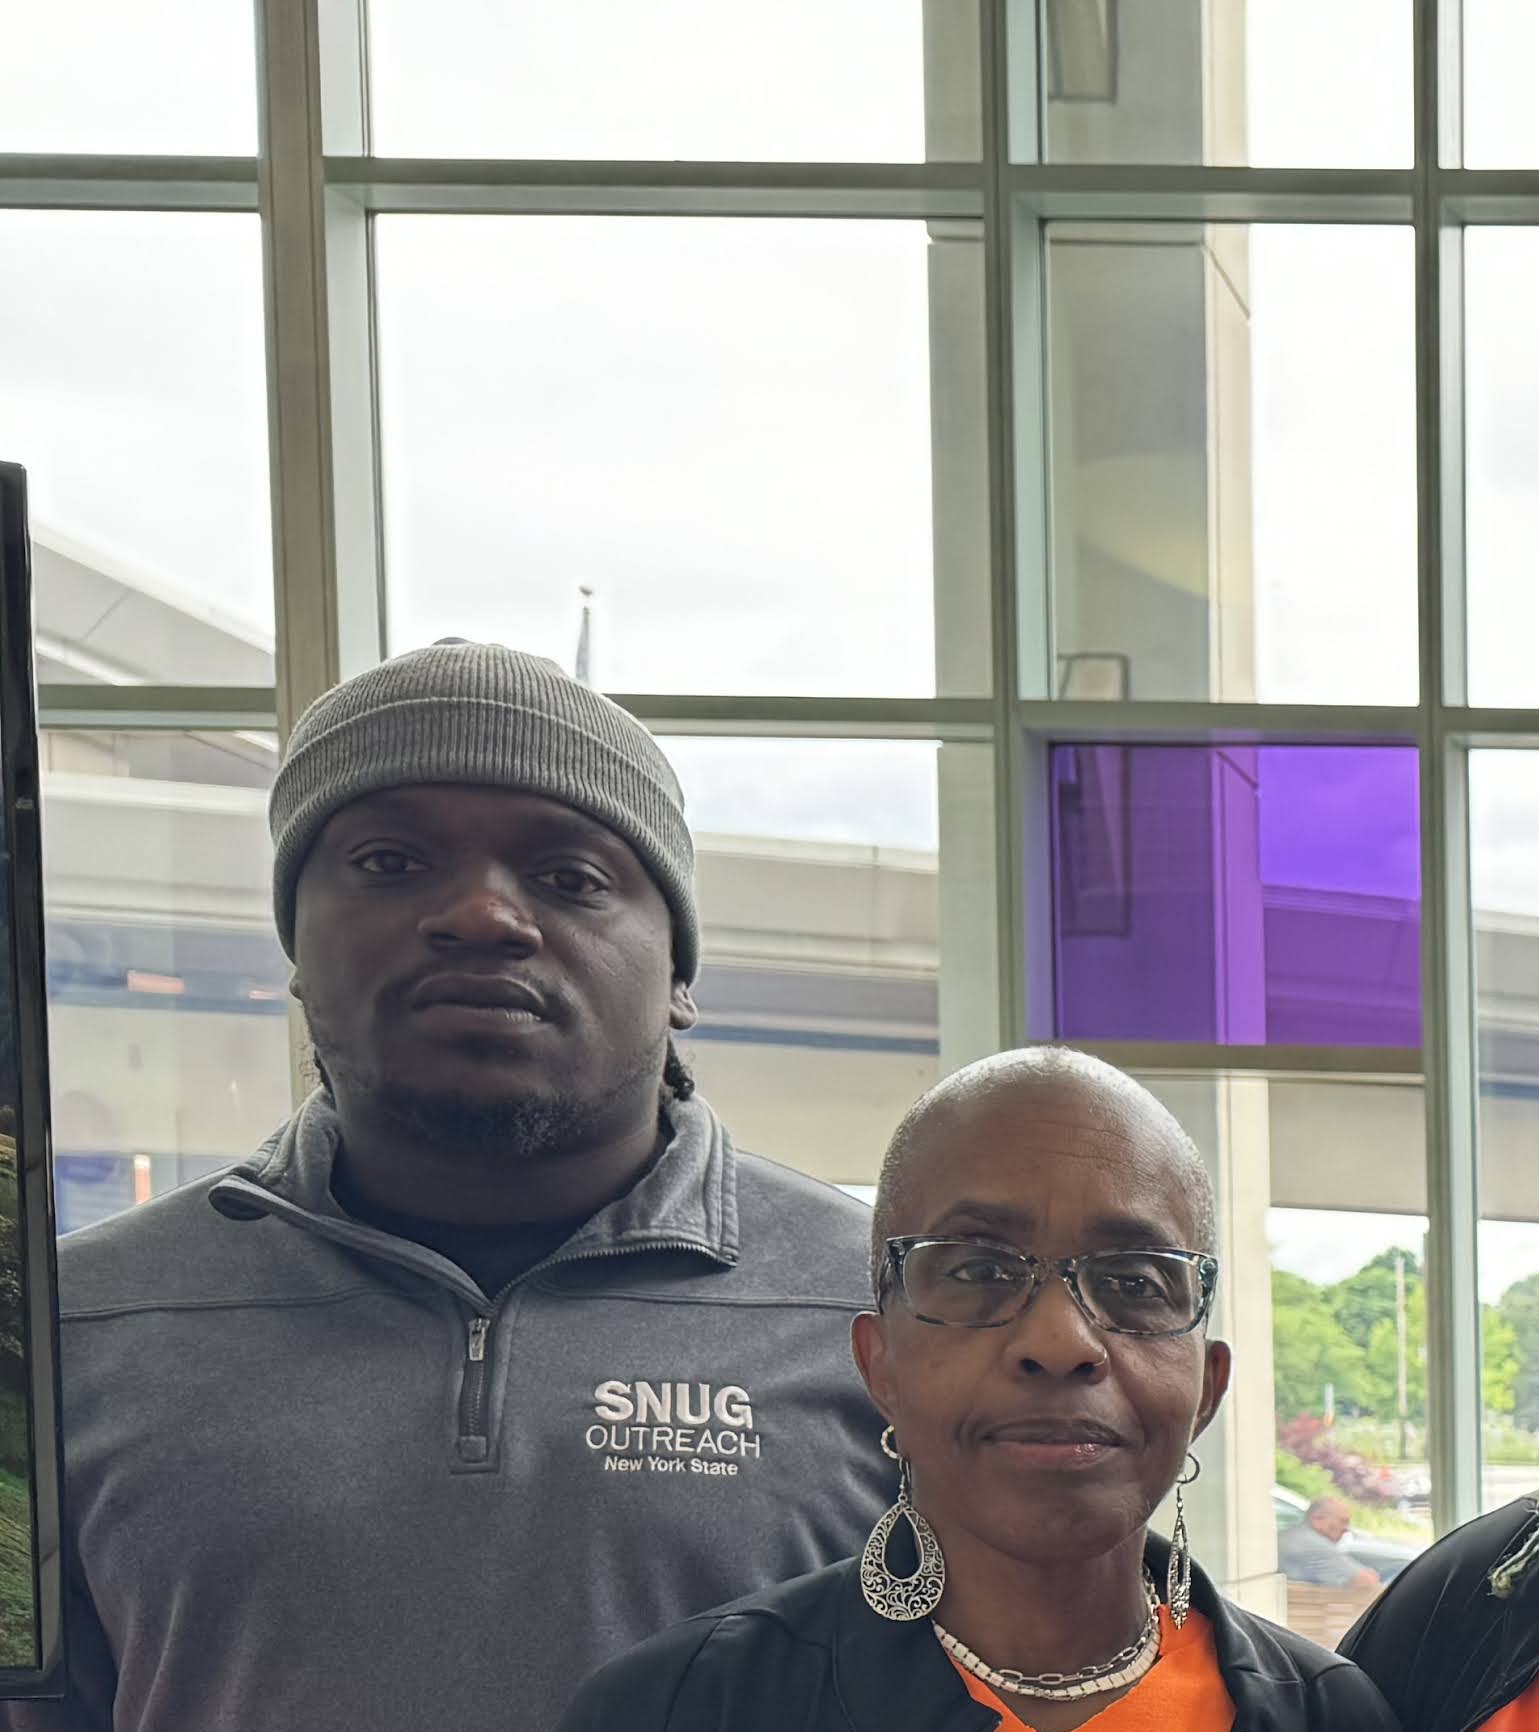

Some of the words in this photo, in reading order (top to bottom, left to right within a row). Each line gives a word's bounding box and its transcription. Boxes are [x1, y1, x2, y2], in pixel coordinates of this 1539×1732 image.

[595, 1380, 753, 1429] SNUG
[586, 1425, 760, 1458] OUTREACH
[604, 1456, 643, 1472] New
[648, 1456, 686, 1472] York
[690, 1458, 738, 1476] State
